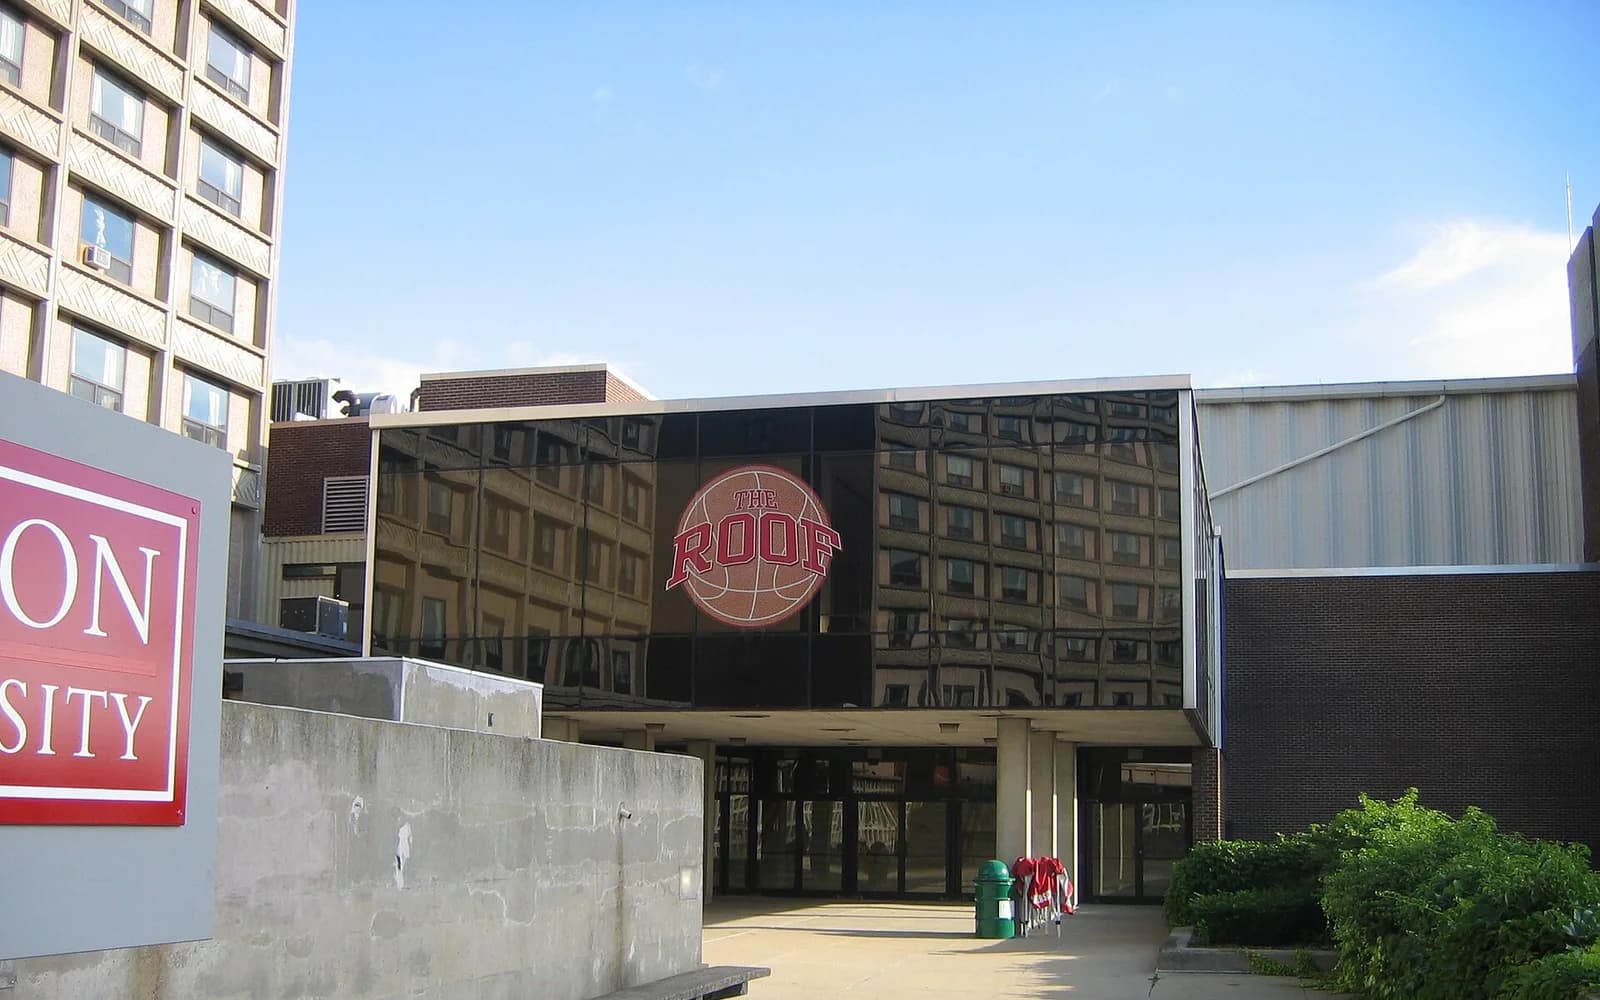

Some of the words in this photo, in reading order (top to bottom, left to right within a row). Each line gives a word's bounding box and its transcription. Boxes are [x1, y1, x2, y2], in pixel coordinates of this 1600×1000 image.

[734, 489, 778, 511] THE
[0, 519, 161, 645] ON
[665, 512, 842, 591] ROOF
[0, 679, 153, 761] SITY
